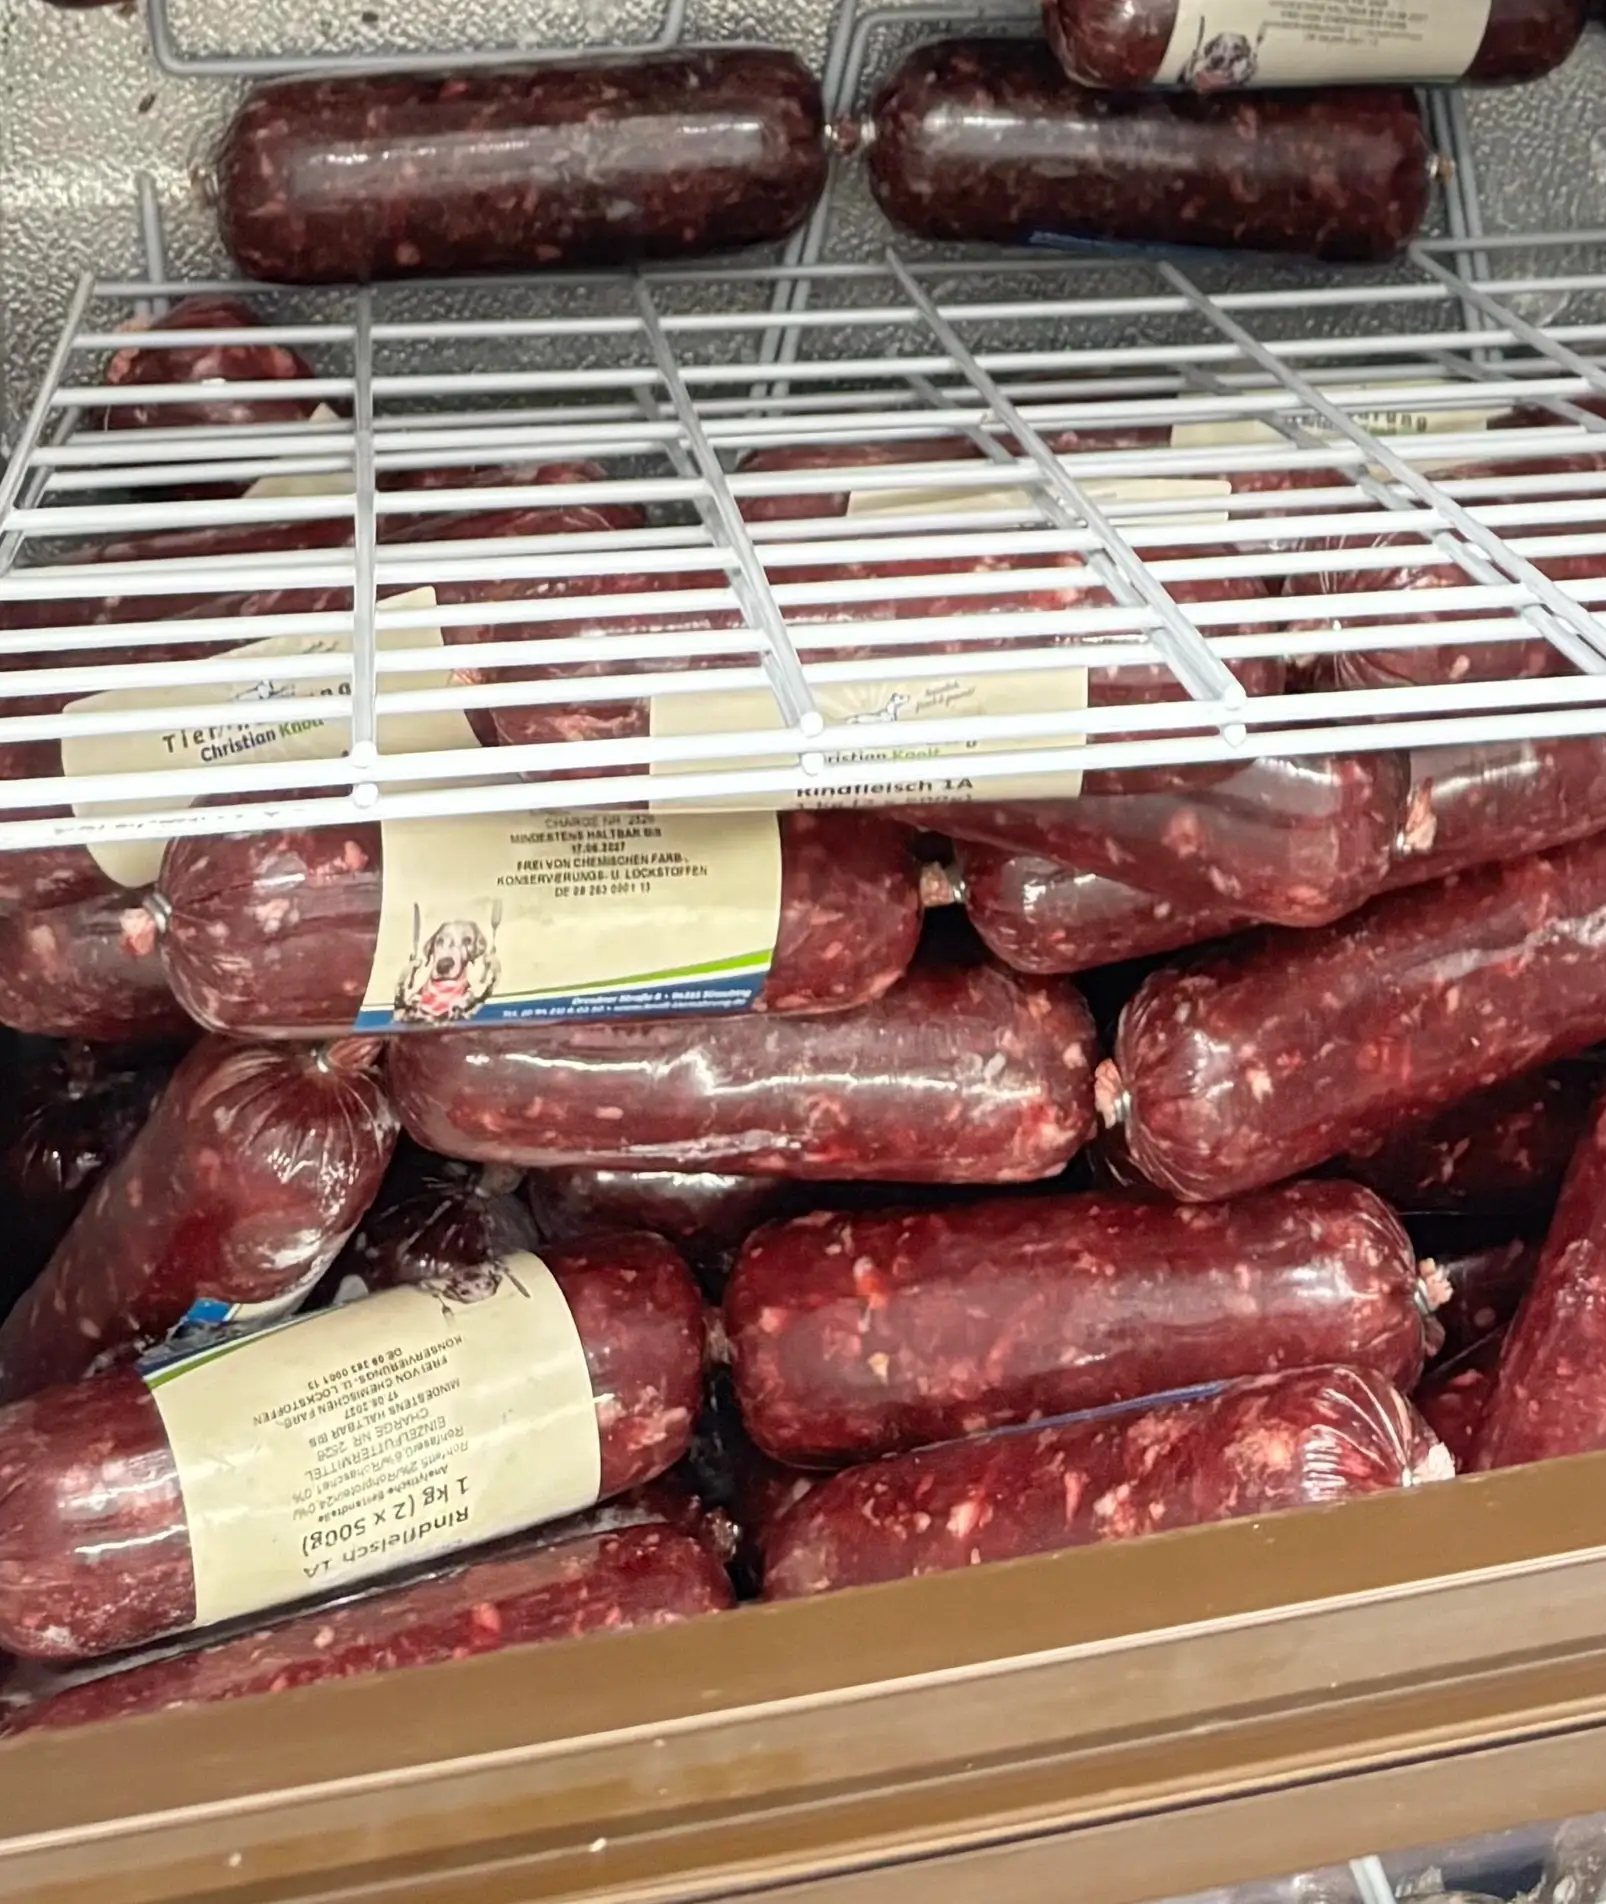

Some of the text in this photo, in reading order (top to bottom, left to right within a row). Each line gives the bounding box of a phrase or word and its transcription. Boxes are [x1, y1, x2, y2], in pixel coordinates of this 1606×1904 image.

[201, 730, 276, 762] Christian
[945, 778, 973, 790] 1A
[253, 1386, 338, 1425] LOCKSTOFFEN
[318, 1356, 447, 1414] FREI VON CHEMISCHEN
[309, 1378, 460, 1448] MINDESTENS HALTBAR BIS
[374, 1408, 429, 1438] CHARGE
[304, 1416, 446, 1481] EINZELFUTTERMITTEL
[303, 1476, 467, 1557] 1 kg (2 x 500g)
[343, 1506, 468, 1561] Rindfleisch
